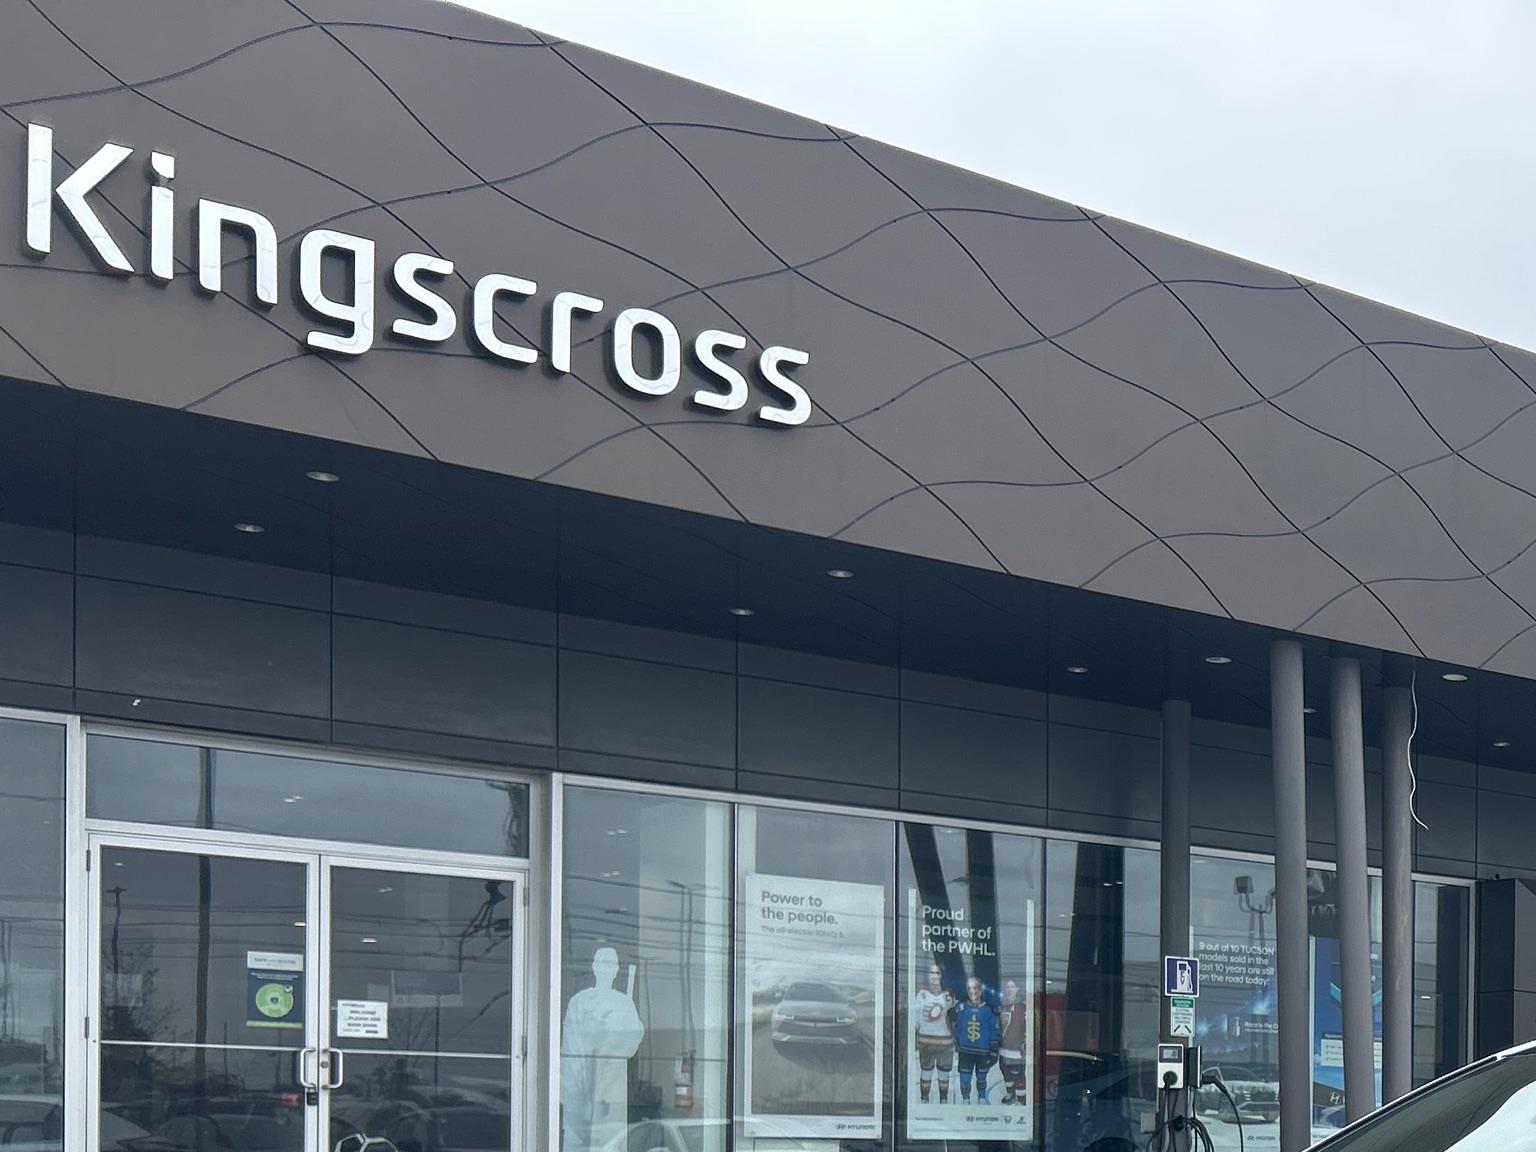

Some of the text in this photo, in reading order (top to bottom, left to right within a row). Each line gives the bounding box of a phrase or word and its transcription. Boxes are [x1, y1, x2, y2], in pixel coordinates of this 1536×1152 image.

[26, 122, 812, 427] Kingscross
[761, 890, 822, 907] Power to
[761, 906, 838, 925] the people.
[922, 905, 964, 920] Proud
[922, 925, 992, 939] partner of
[922, 938, 996, 956] the PWHL.
[1199, 942, 1275, 955] 9 out of 10 TUCSON
[1199, 953, 1269, 965] models sold in the
[1215, 963, 1223, 971] 10
[1225, 965, 1246, 974] years
[1247, 967, 1260, 975] are
[1262, 967, 1275, 976] still
[1199, 974, 1209, 982] on
[1211, 974, 1223, 982] the
[1225, 976, 1243, 984] road
